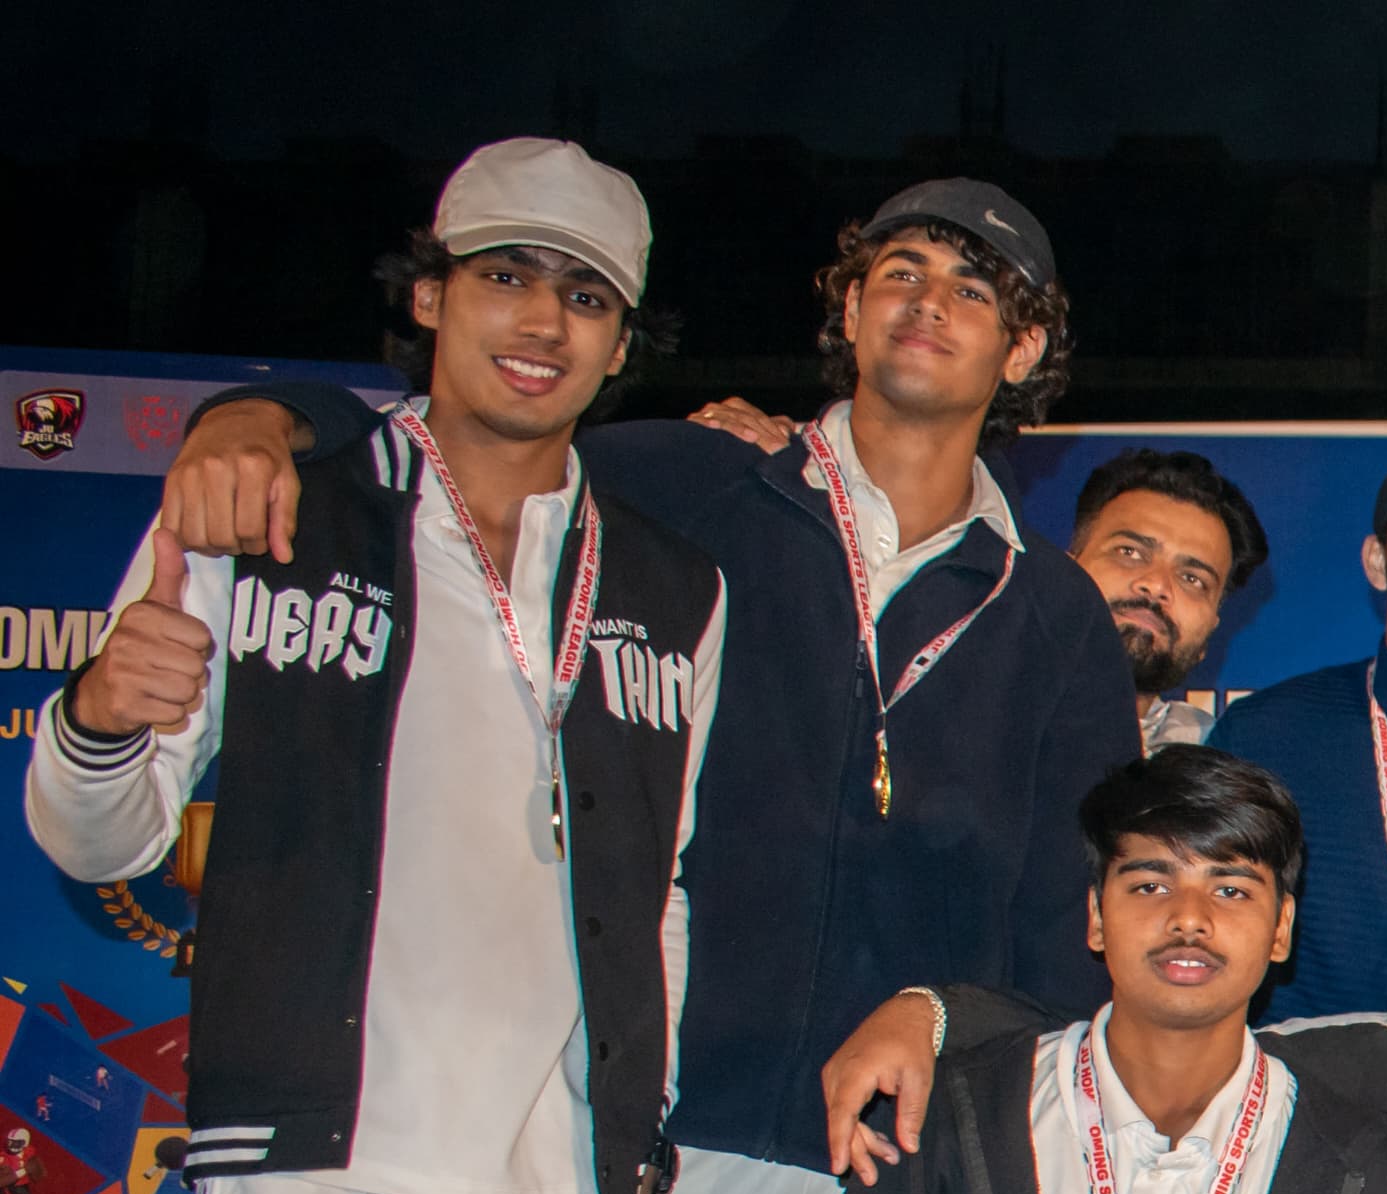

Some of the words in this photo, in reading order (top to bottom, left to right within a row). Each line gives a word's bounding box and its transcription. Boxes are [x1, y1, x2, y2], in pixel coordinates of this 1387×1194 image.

[401, 412, 444, 466] LEAGUE
[822, 460, 850, 516] COMING
[842, 518, 864, 579] SPORTS
[330, 572, 363, 594] ALL
[366, 583, 394, 606] WE
[574, 566, 594, 621] SPORTS
[497, 595, 522, 647] HOME
[592, 618, 633, 636] WANT
[634, 624, 648, 640] IS
[558, 622, 584, 684] LEAGUE
[588, 639, 693, 732] THIN
[1081, 1066, 1096, 1103] HOM
[1088, 1124, 1109, 1182] OMING
[1228, 1098, 1259, 1160] SPORTS
